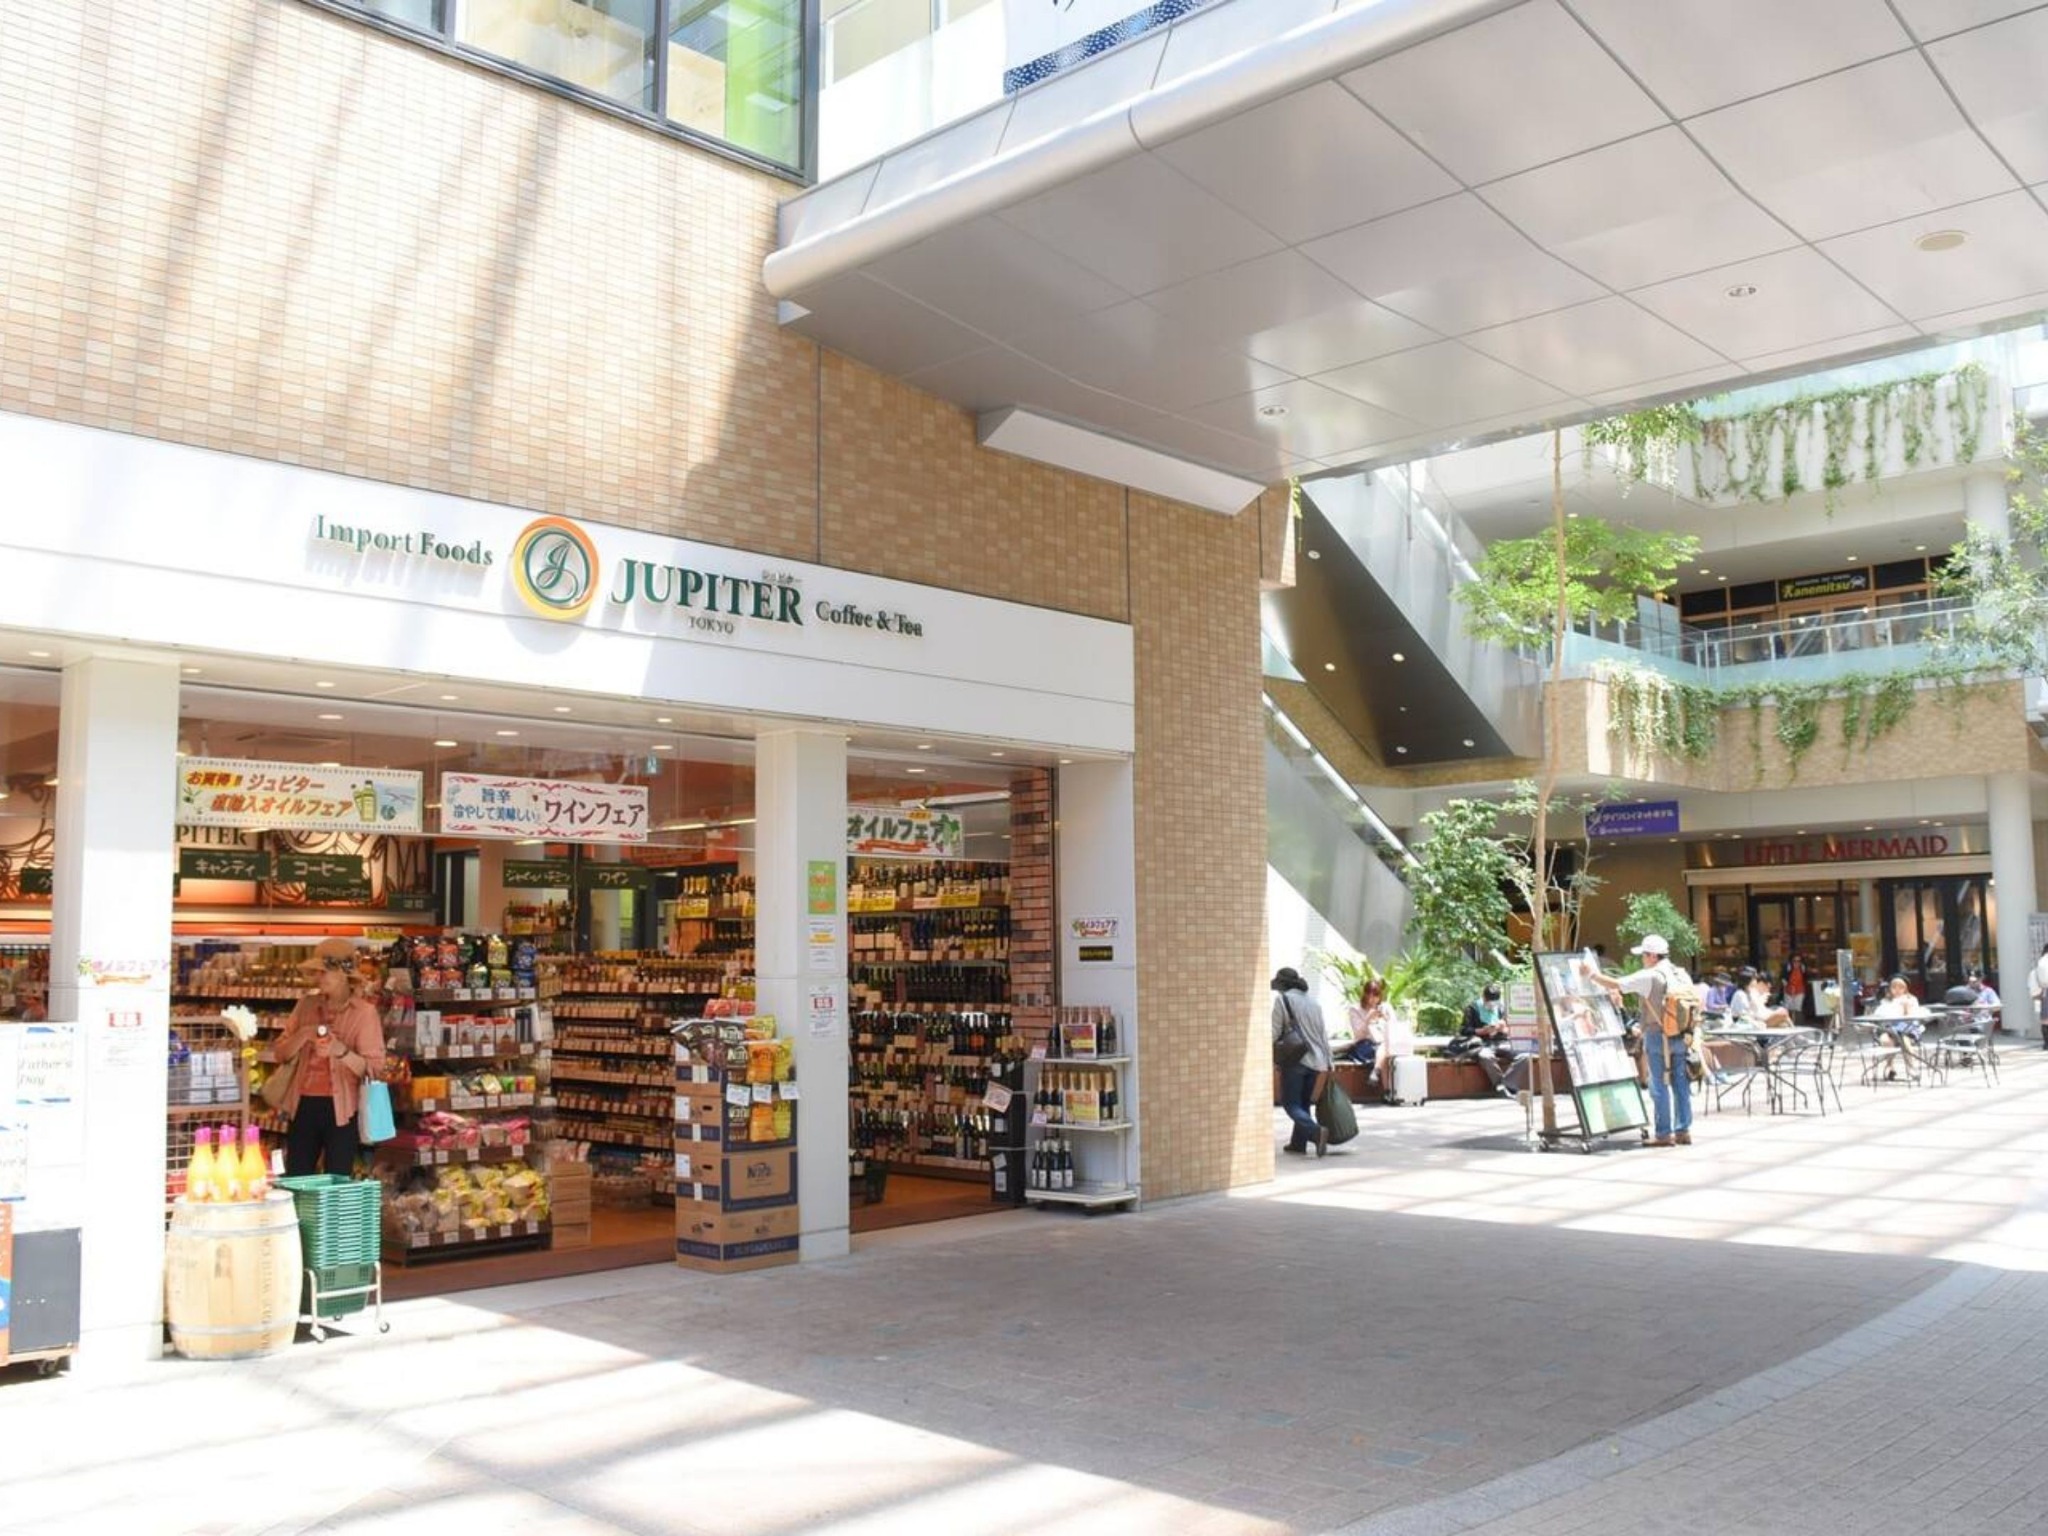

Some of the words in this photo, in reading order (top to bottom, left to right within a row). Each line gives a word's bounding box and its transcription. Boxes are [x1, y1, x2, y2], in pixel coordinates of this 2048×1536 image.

[316, 514, 412, 553] Import
[420, 532, 493, 566] Foods
[611, 558, 803, 626] JUPITER
[688, 615, 734, 635] TOKYO
[815, 600, 874, 628] Coffee
[876, 610, 891, 632] &
[893, 612, 923, 637] Tea
[544, 799, 645, 828] ワインフェア
[1821, 834, 1948, 859] MERMAID
[293, 861, 348, 876] コーヒー
